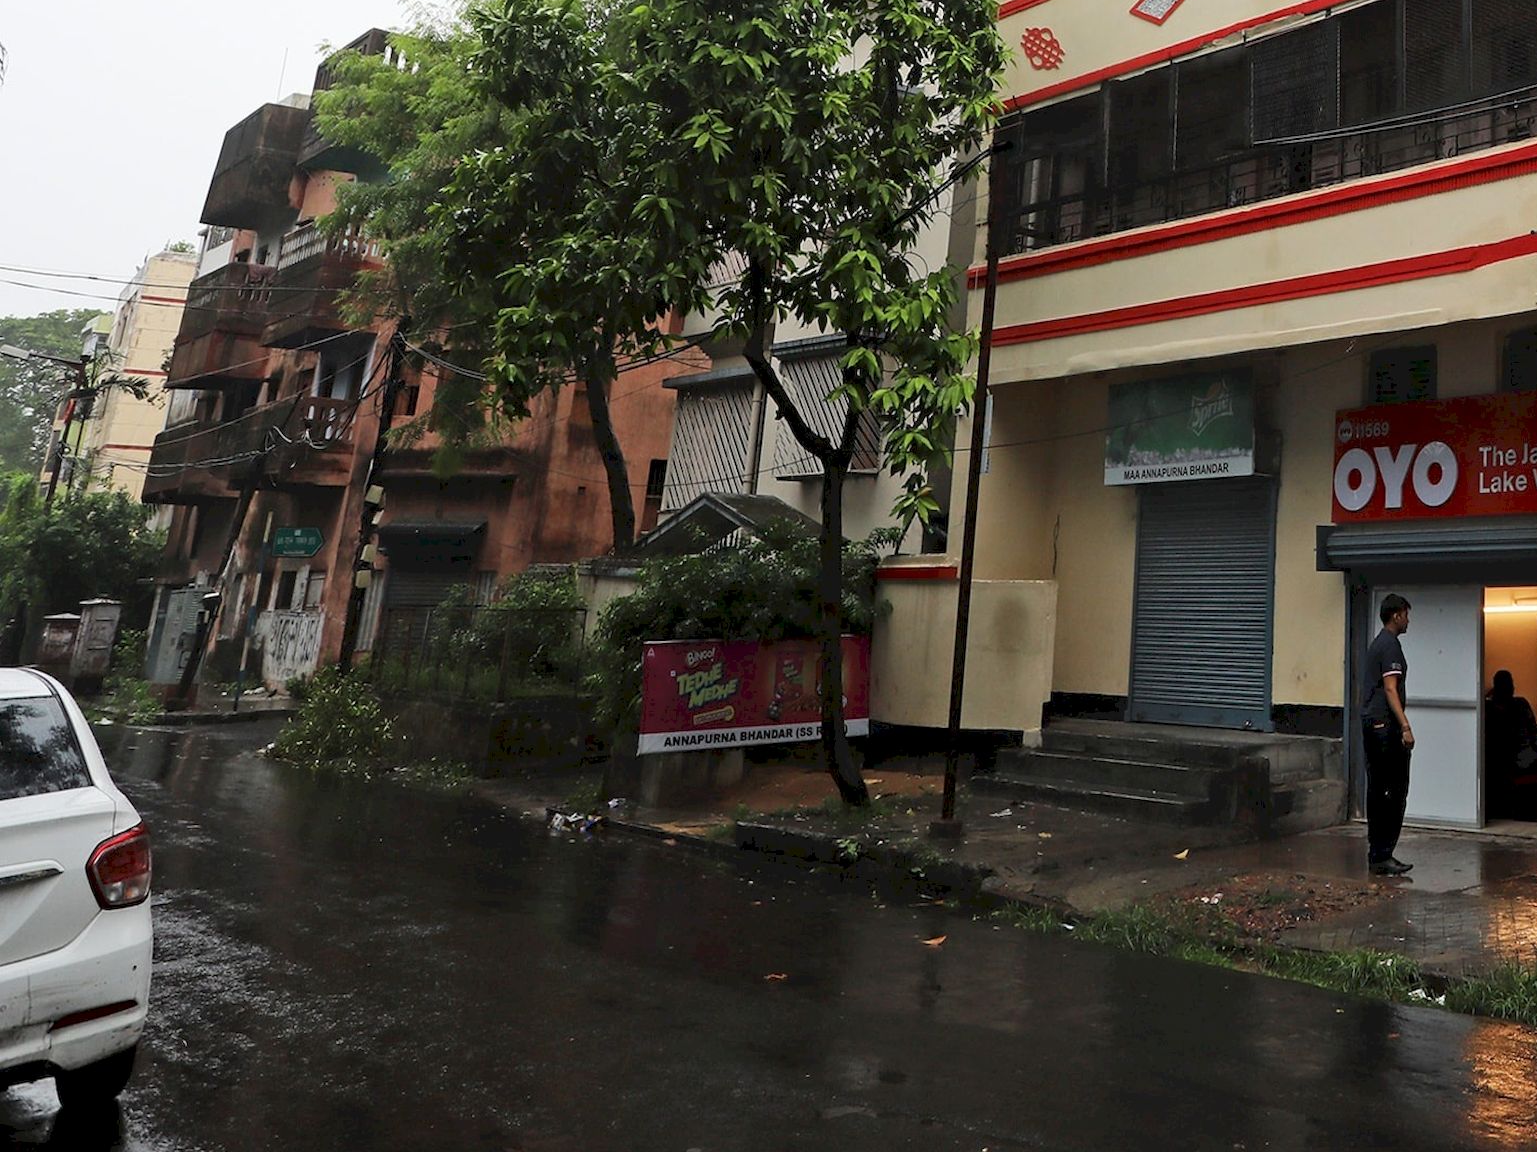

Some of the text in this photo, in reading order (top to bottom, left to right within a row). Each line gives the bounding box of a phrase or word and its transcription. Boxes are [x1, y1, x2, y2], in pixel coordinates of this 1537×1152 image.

[1479, 445, 1517, 467] The
[1123, 462, 1229, 481] MAA ANNAPURNA BHANDAR
[1333, 441, 1458, 512] OYO
[1479, 470, 1528, 494] Lake
[676, 662, 724, 696] TEDHE
[688, 678, 738, 709] MEDHE
[664, 729, 736, 747] ANNAPURNA
[740, 727, 793, 742] BHANDAR
[796, 727, 815, 739] (SS
